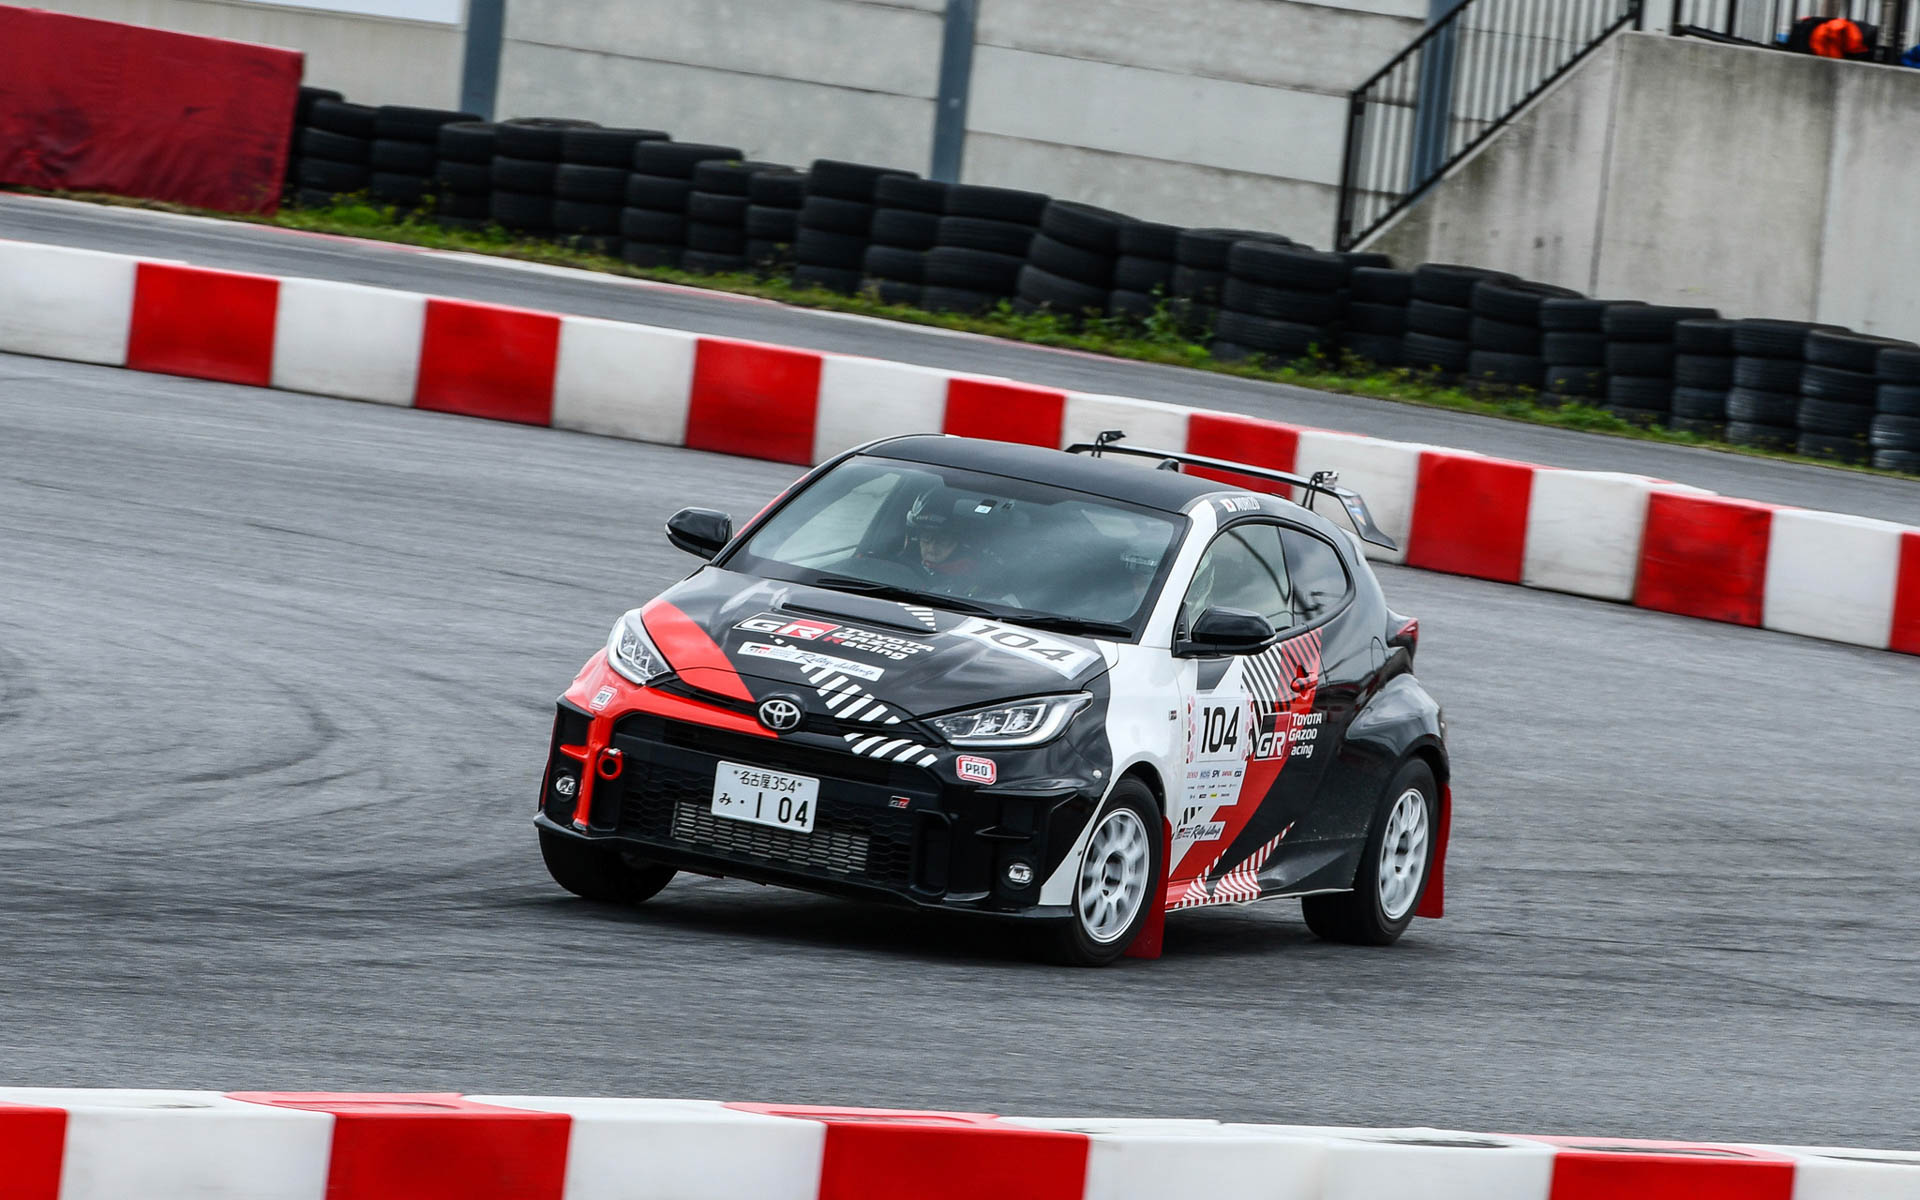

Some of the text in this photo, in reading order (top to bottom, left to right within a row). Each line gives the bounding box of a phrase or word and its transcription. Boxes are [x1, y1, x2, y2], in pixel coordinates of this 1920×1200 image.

[741, 618, 825, 639] GR
[843, 627, 936, 652] TOYOTA
[823, 635, 910, 660] Racing
[832, 631, 919, 654] GAZOO
[970, 624, 1076, 662] 104
[1200, 706, 1240, 754] 104
[1292, 712, 1322, 727] TOYOTA
[1256, 731, 1286, 757] GR
[1288, 728, 1318, 742] GAZOO
[965, 763, 988, 776] PRO
